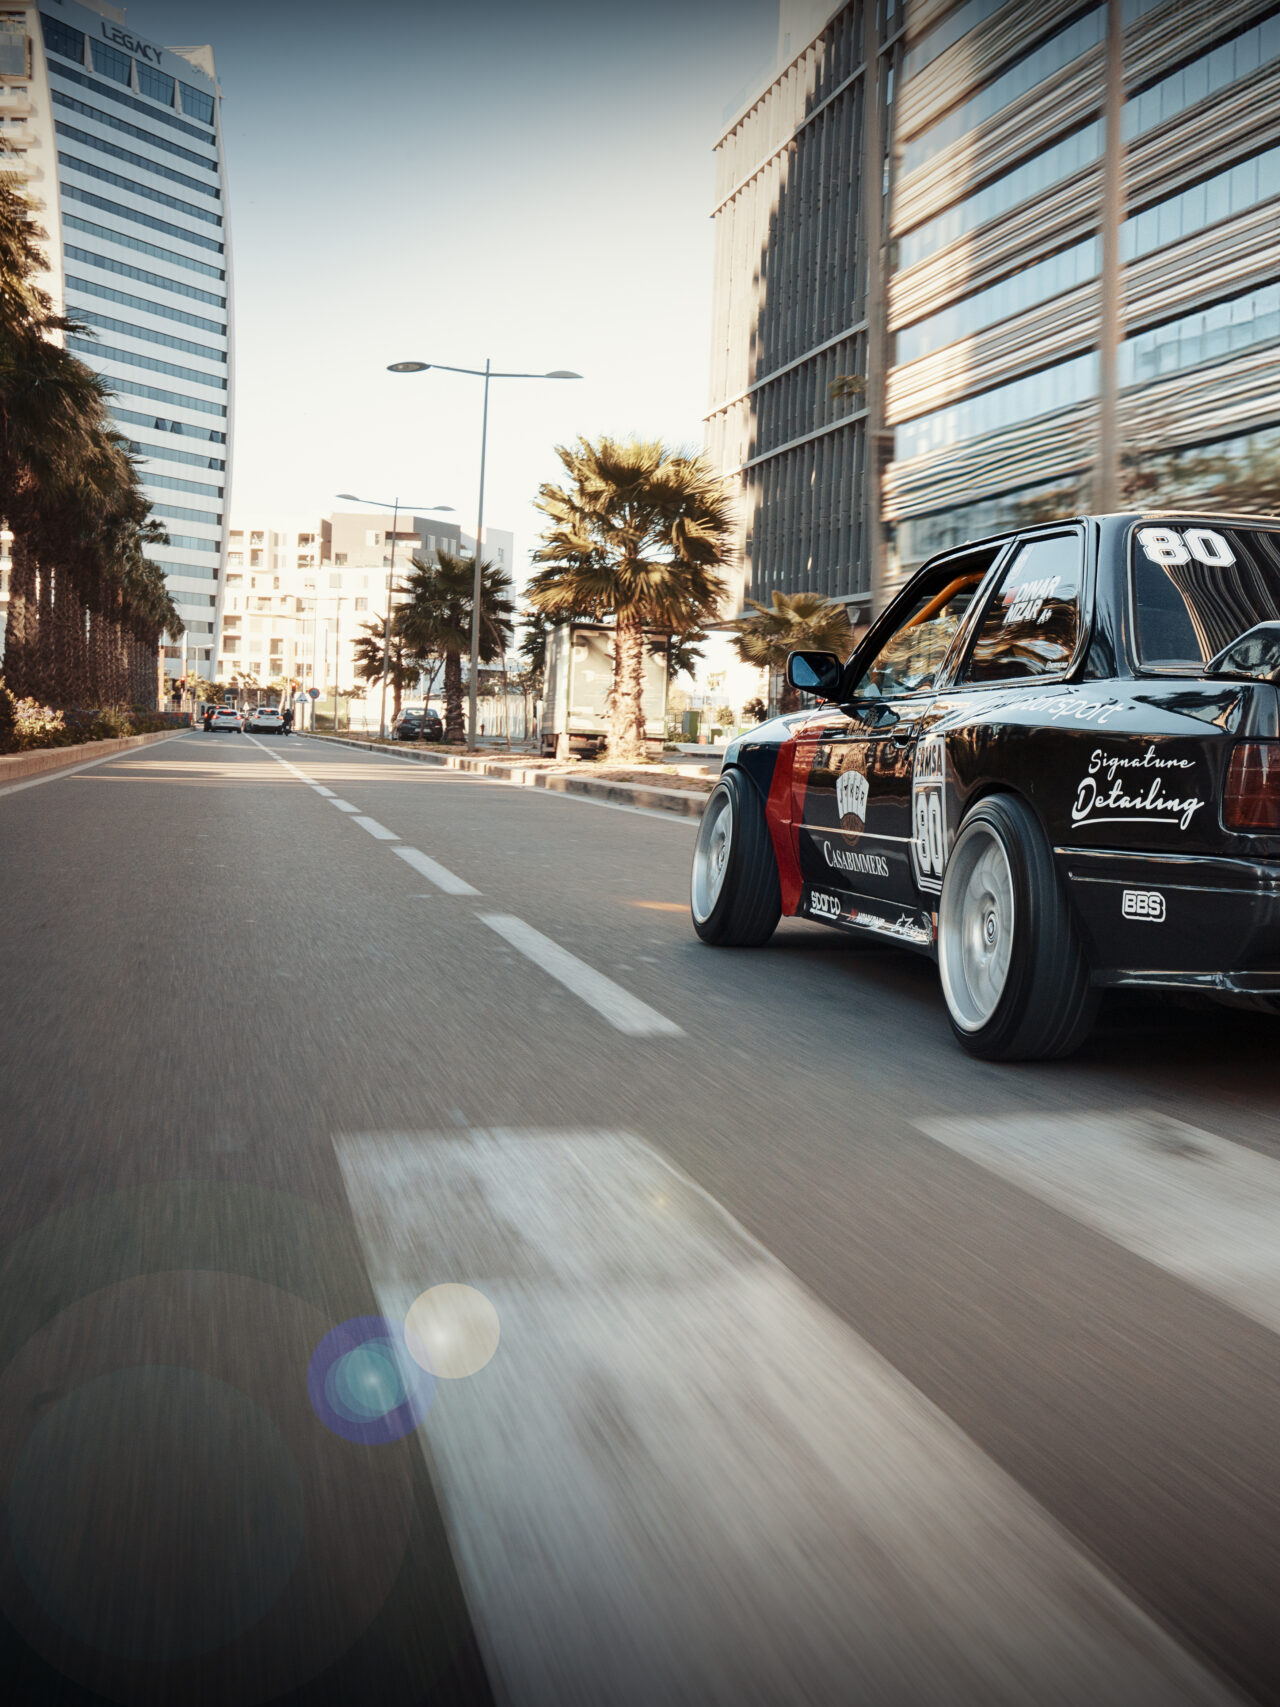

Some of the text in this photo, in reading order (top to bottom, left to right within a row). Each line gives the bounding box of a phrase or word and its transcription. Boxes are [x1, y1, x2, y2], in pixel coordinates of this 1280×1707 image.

[101, 22, 162, 64] LEGACY
[1136, 527, 1237, 568] 80
[1013, 576, 1061, 603] DINAR
[1002, 599, 1043, 625] NIZAR
[1088, 745, 1196, 781] Signature
[1071, 776, 1205, 831] Detailing
[916, 791, 945, 877] 80
[1124, 894, 1161, 916] BBS
